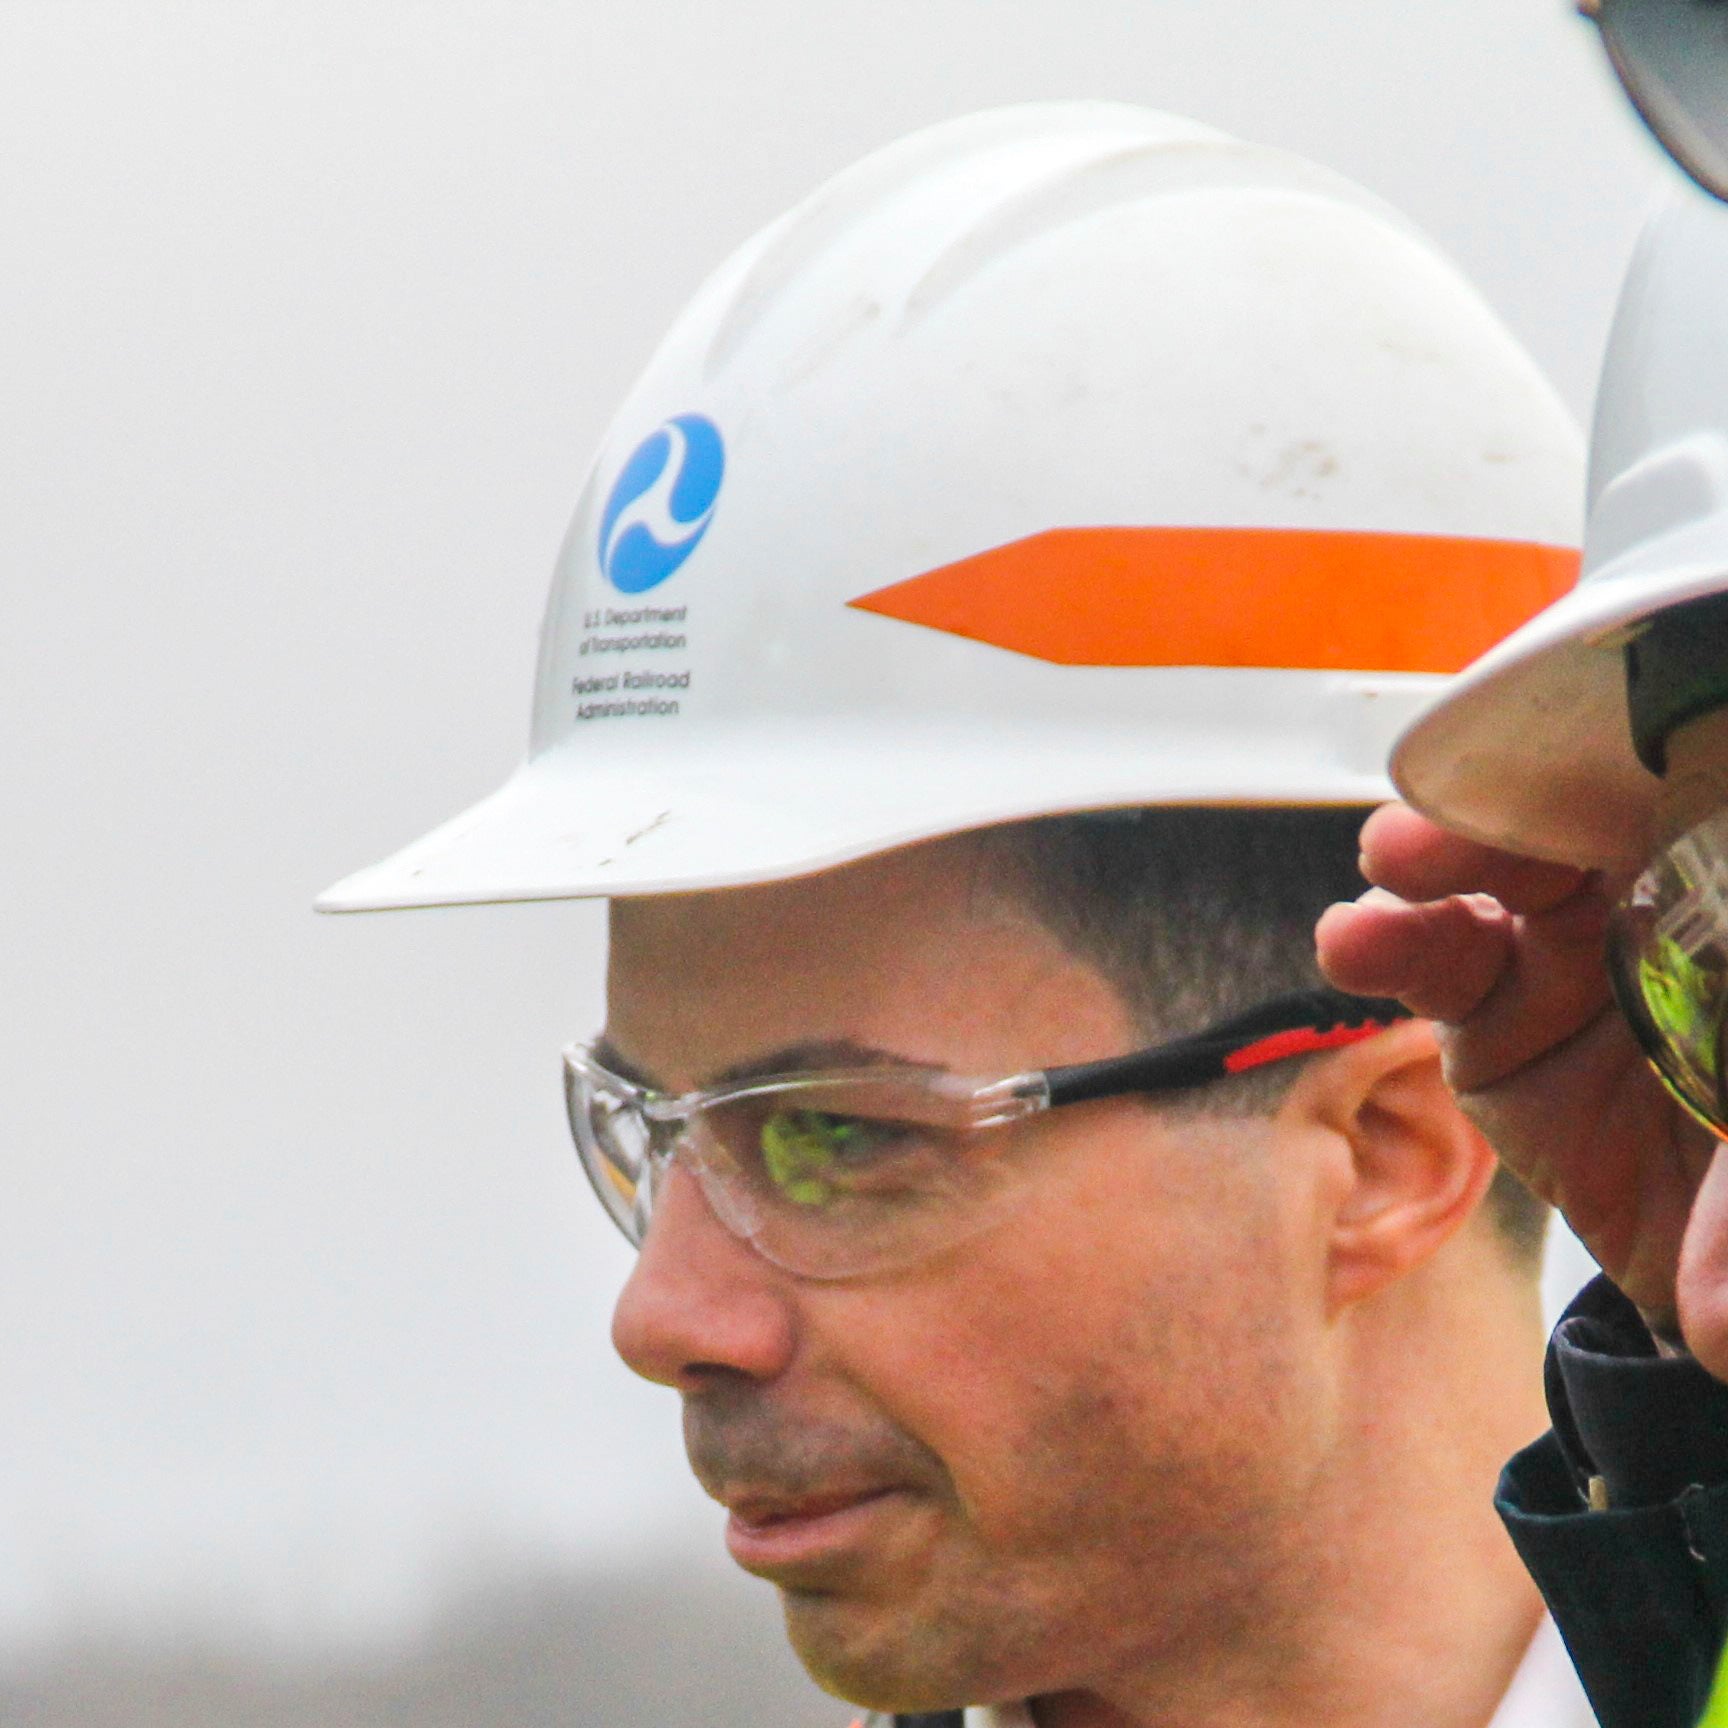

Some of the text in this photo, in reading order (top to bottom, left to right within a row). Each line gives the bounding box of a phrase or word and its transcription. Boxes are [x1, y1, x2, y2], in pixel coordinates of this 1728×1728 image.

[604, 605, 687, 626] Department
[590, 633, 686, 653] Transportation
[572, 669, 691, 694] Federal Railroad
[576, 699, 679, 720] Administration
